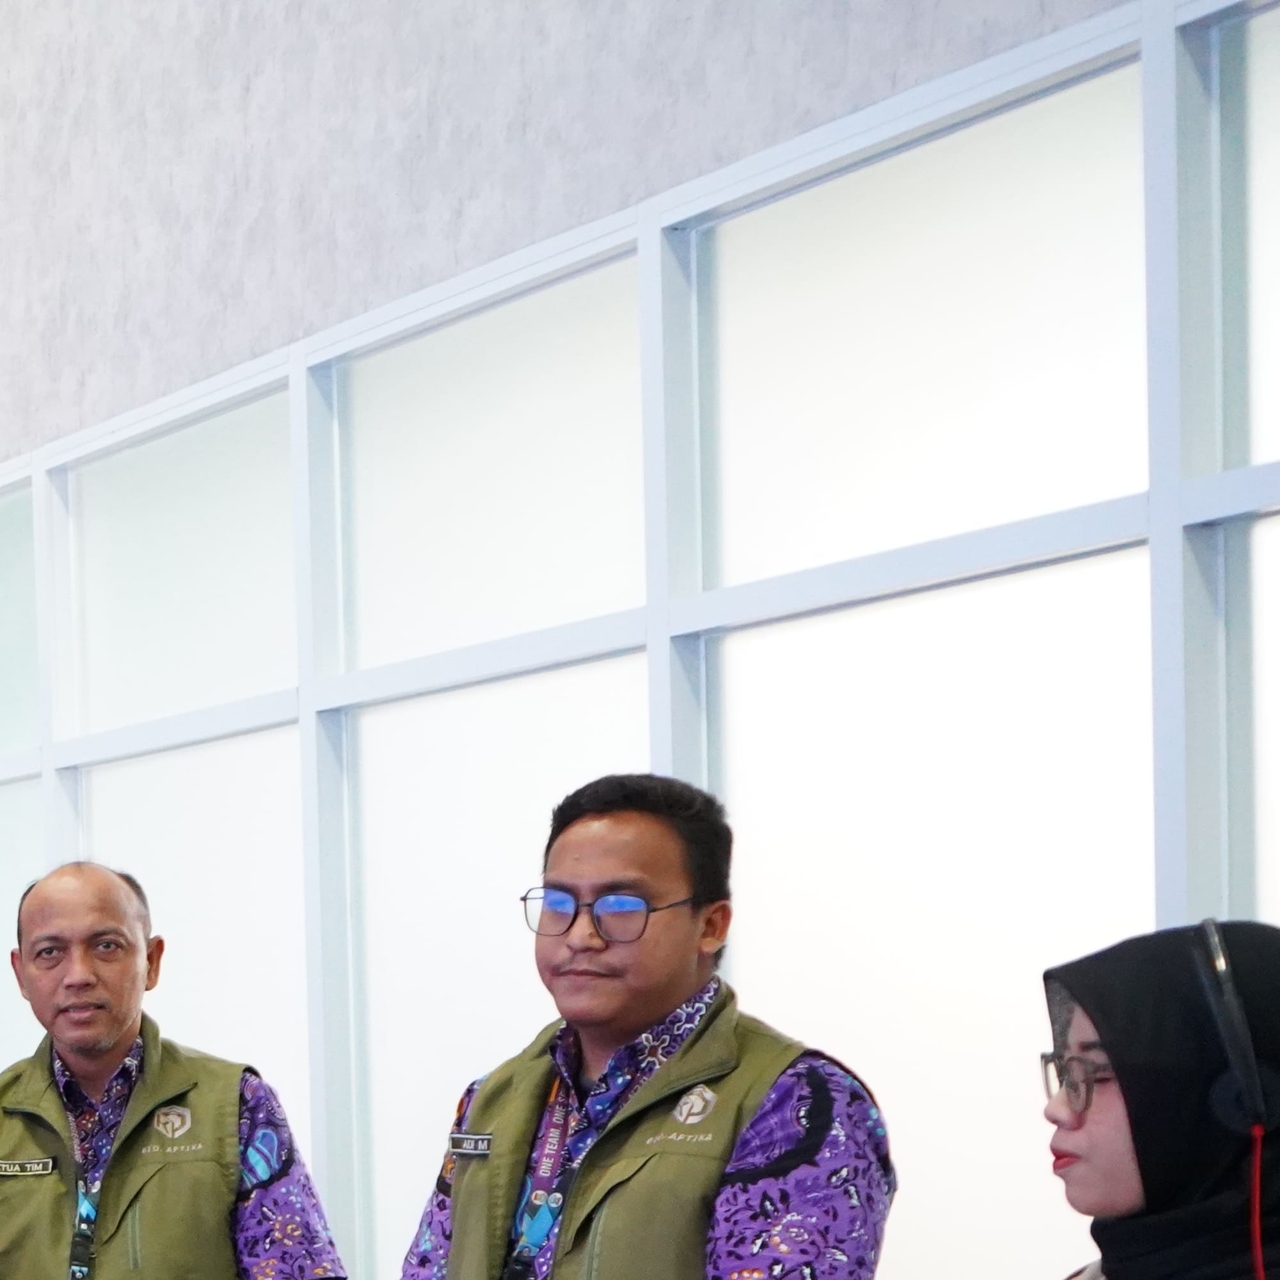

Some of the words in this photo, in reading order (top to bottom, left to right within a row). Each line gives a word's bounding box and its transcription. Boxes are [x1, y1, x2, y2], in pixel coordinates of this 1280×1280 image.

[478, 1139, 488, 1150] M
[539, 1156, 555, 1177] ONE
[553, 1104, 567, 1125] ONE
[165, 1143, 203, 1153] APTIKA
[24, 1163, 43, 1172] TIM
